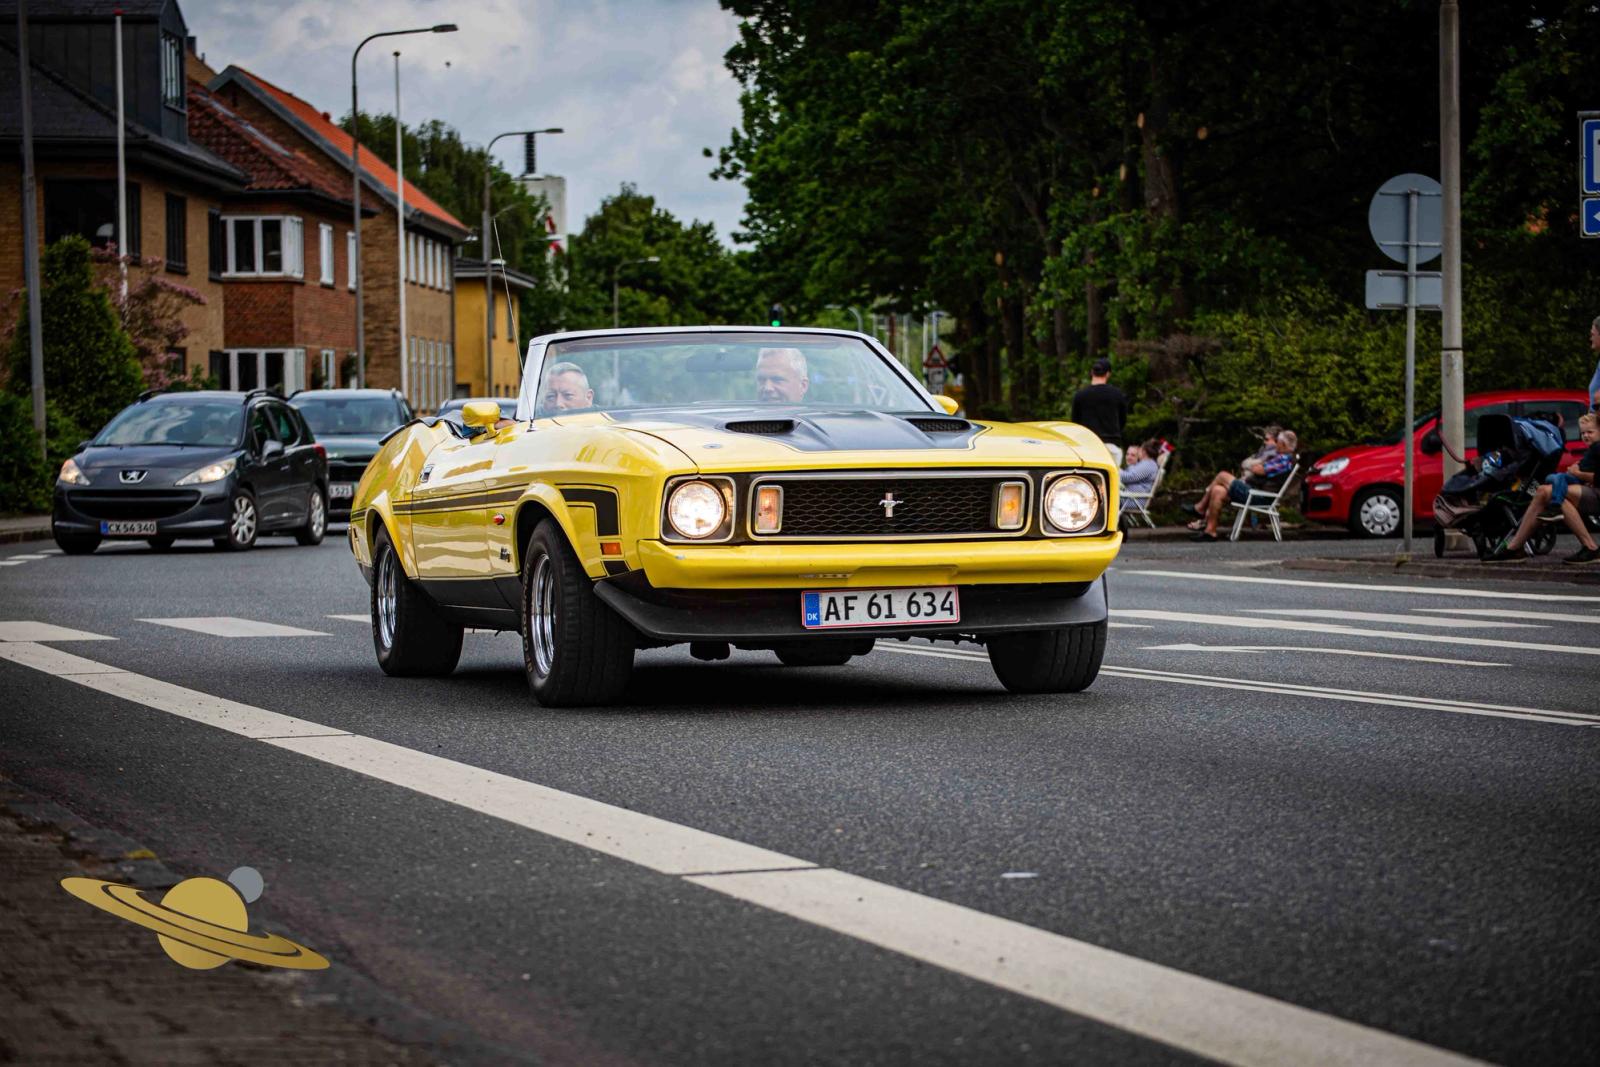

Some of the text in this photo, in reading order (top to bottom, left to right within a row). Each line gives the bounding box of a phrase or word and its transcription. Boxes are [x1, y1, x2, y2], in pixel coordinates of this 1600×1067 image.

[109, 523, 120, 532] CX
[123, 523, 135, 532] 54
[137, 523, 155, 532] 340
[807, 591, 955, 621] DK AF 61 634
